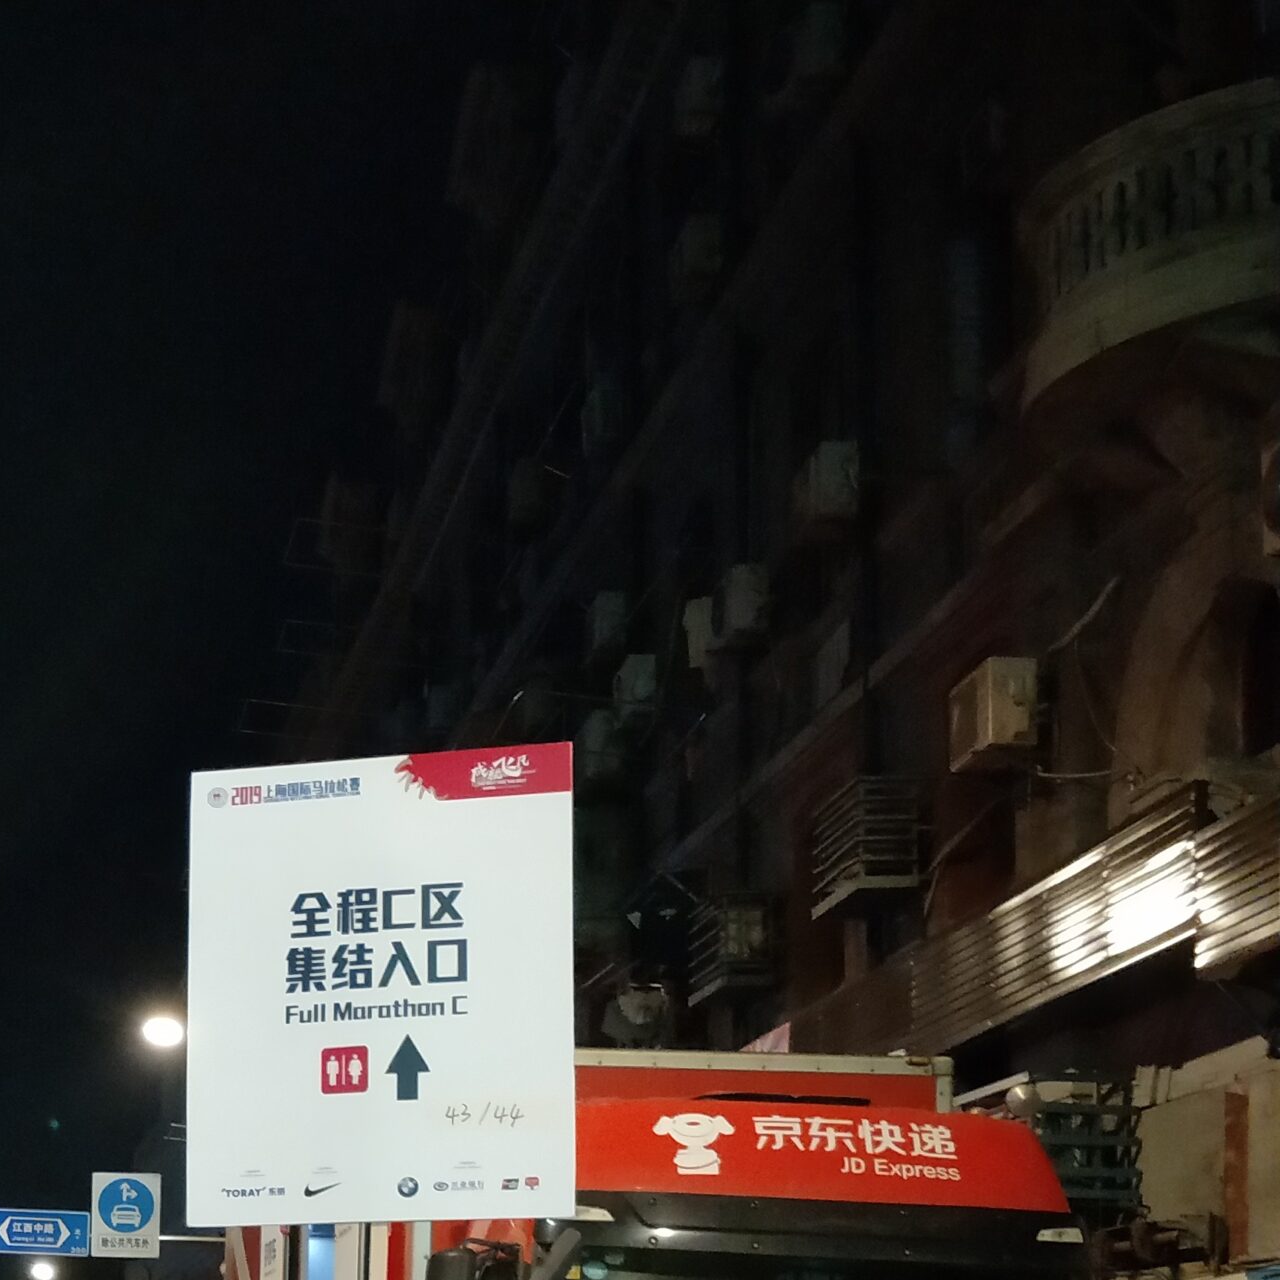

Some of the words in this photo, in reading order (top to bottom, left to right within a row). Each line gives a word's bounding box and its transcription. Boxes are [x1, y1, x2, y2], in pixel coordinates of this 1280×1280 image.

[290, 882, 465, 939] 全程C区
[285, 938, 469, 994] 集结入口
[285, 1003, 326, 1025] Full
[333, 998, 445, 1022] Marathon
[451, 995, 468, 1015] C
[752, 1115, 959, 1160] 京东快递
[840, 1156, 866, 1175] JD
[873, 1158, 962, 1182] Express
